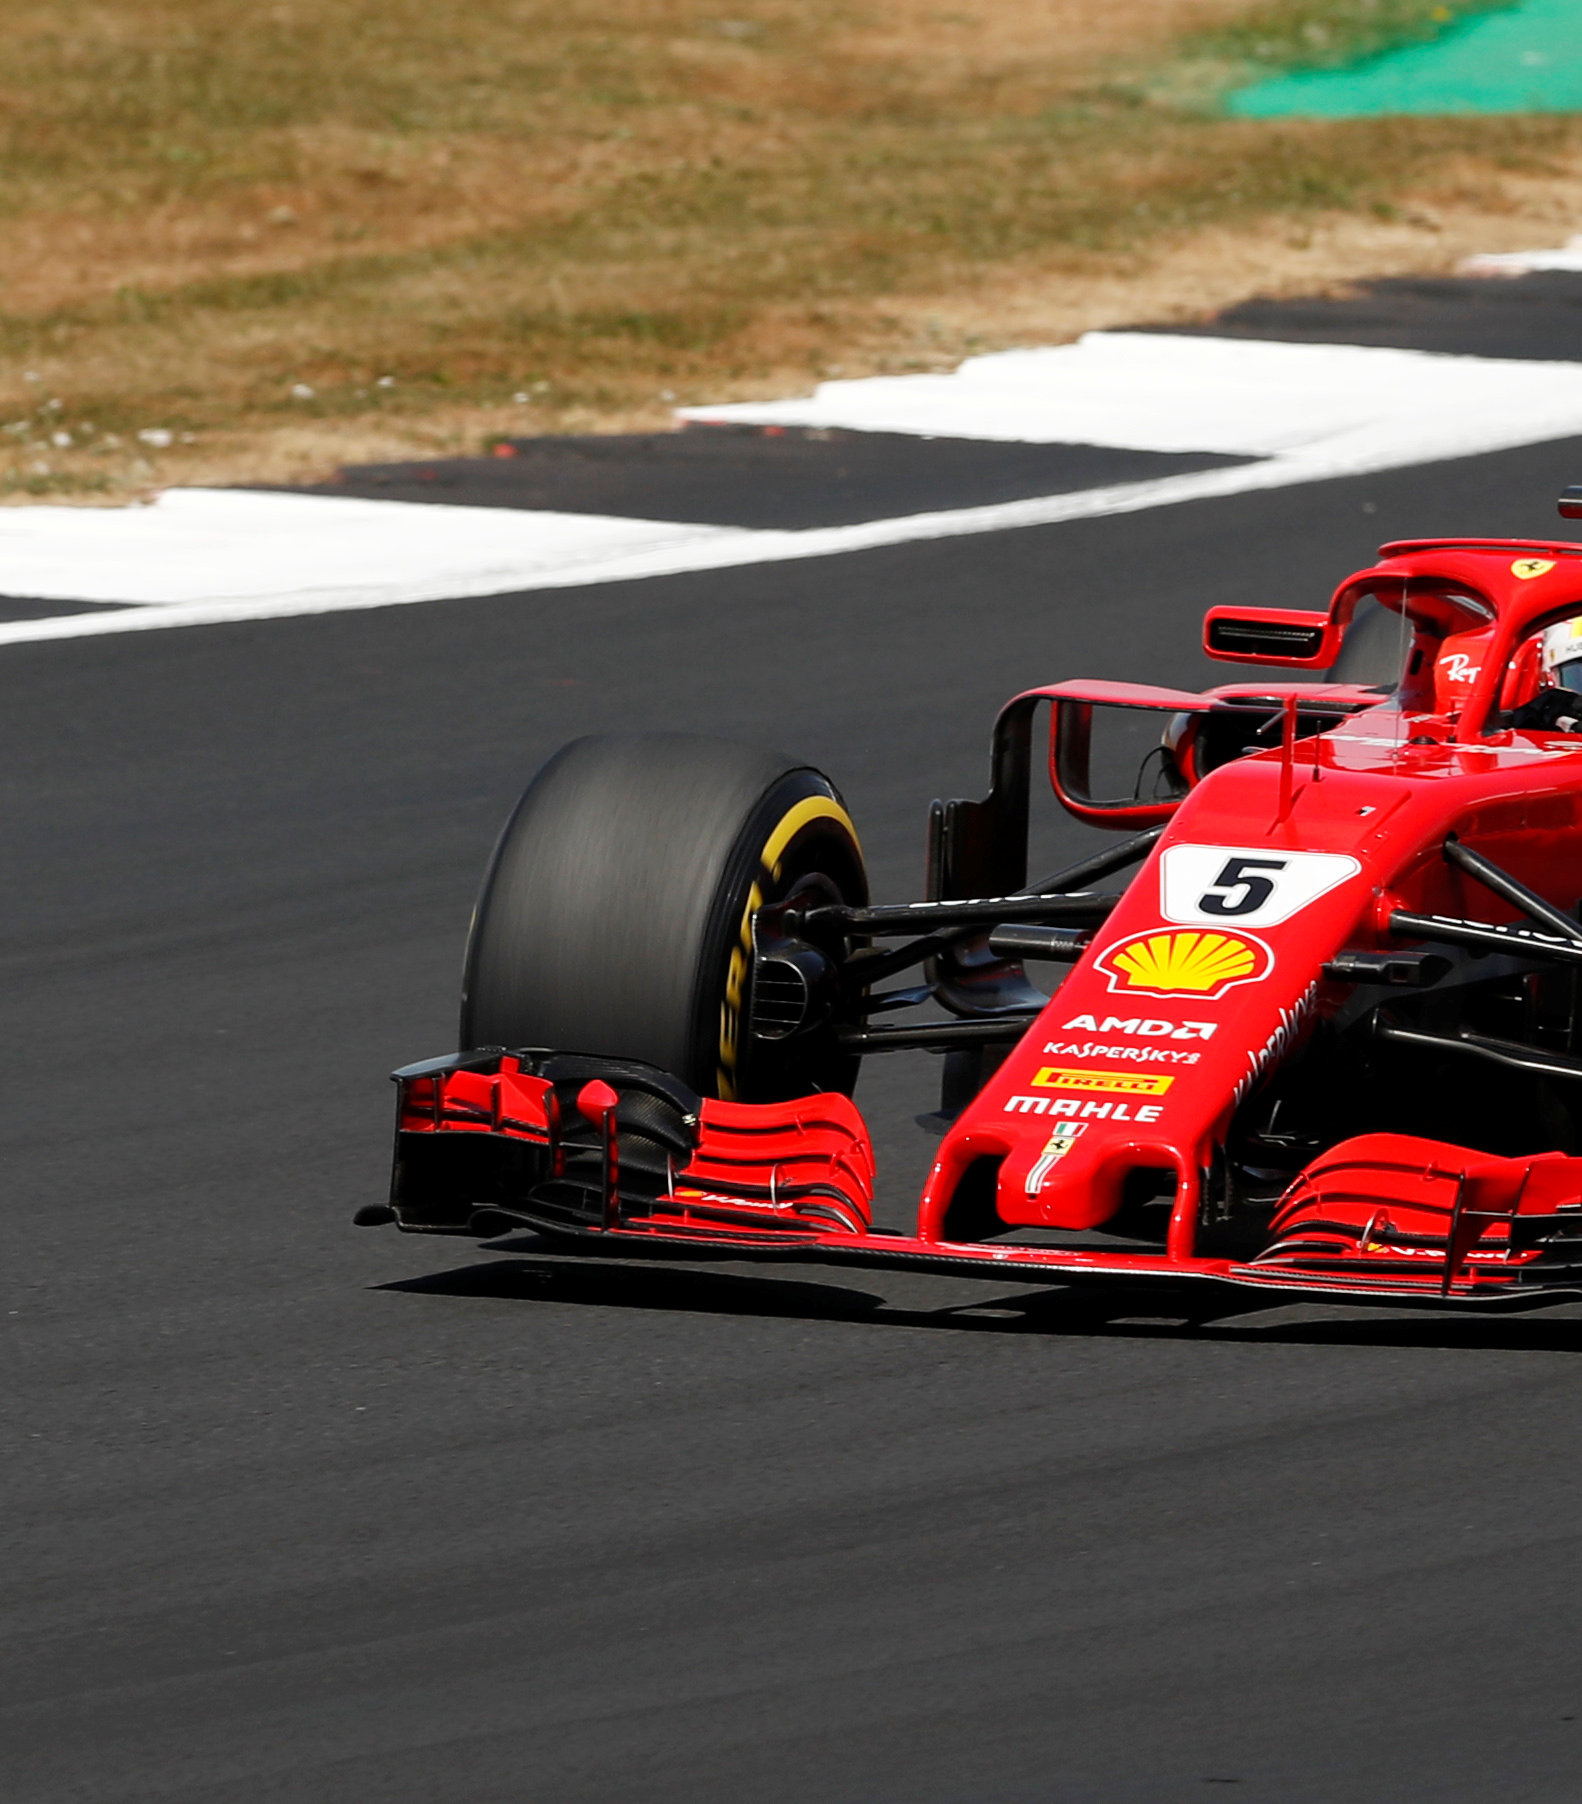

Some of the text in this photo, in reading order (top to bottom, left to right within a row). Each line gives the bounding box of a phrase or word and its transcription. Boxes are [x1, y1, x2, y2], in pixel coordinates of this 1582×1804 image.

[1198, 858, 1286, 916] 5
[1061, 1014, 1175, 1036] AMD
[1043, 1042, 1188, 1063] KASPERSKY
[1045, 1072, 1160, 1090] PIRELLI
[1002, 1096, 1165, 1122] MAHLE
